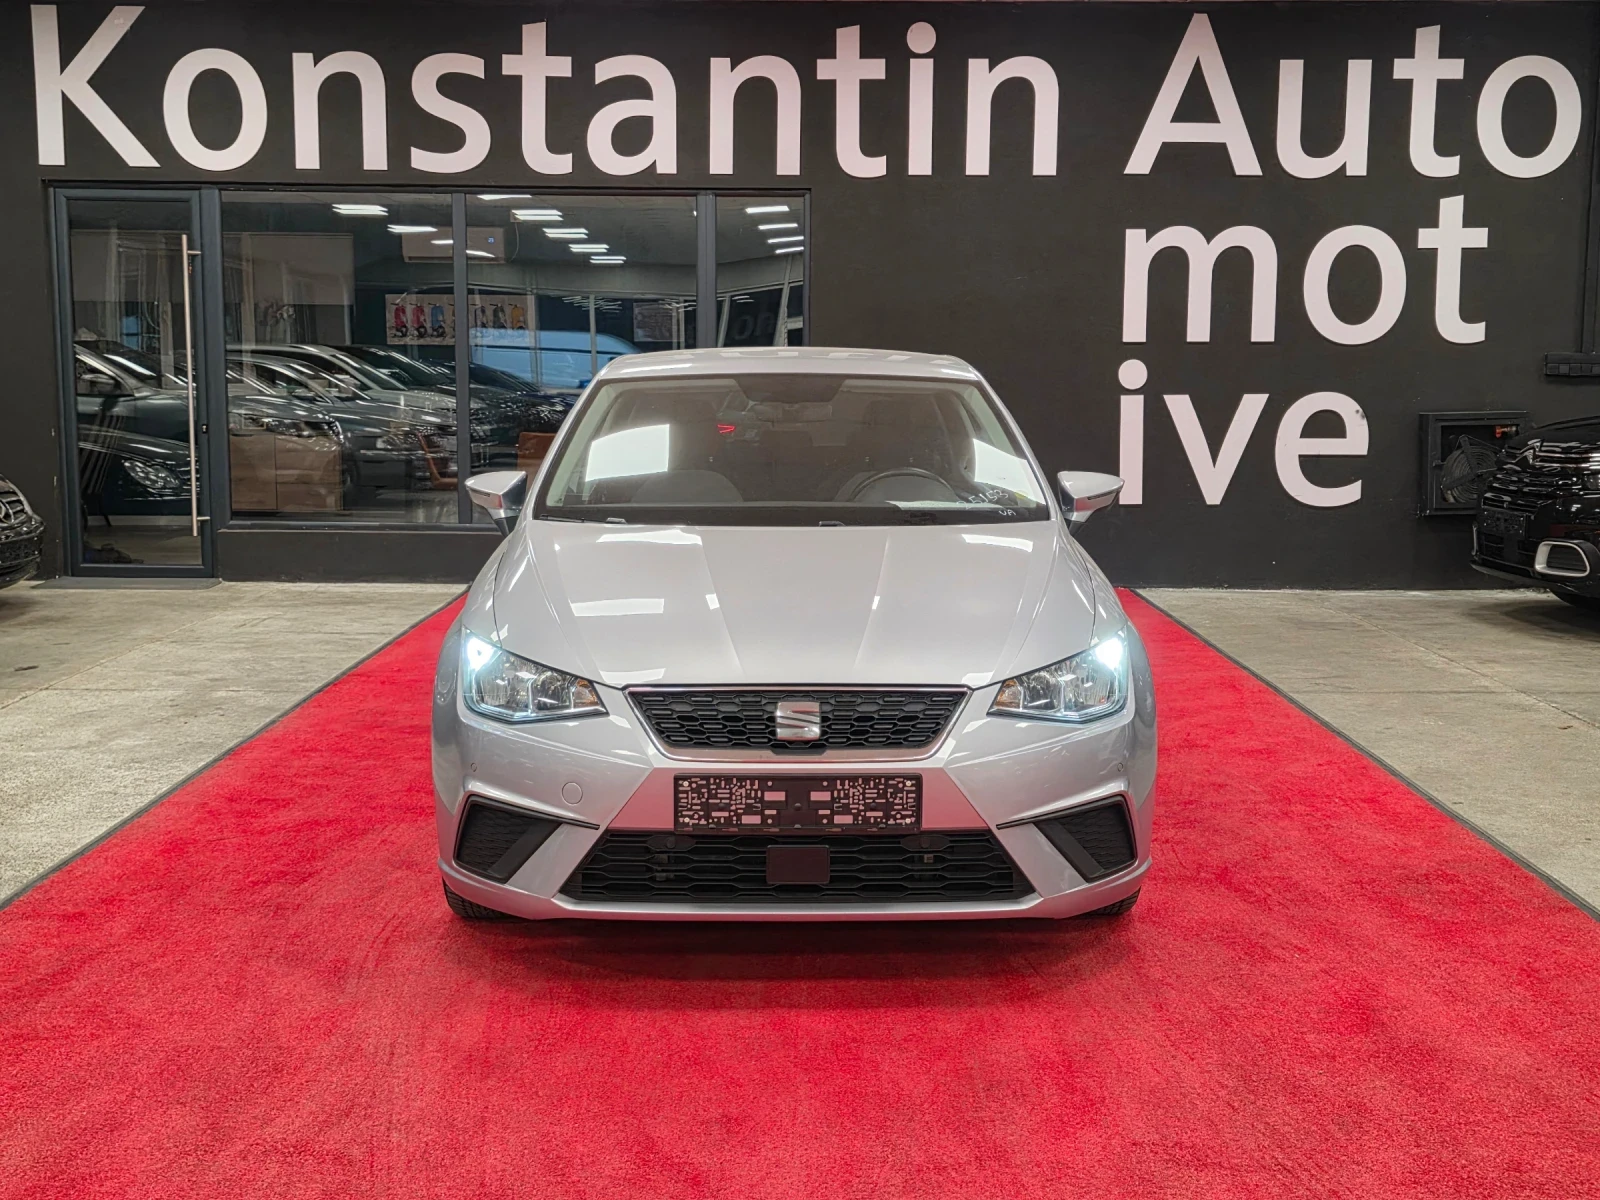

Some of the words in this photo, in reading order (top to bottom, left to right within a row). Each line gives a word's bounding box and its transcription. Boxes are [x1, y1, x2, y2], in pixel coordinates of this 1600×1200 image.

[31, 5, 1060, 177] Konstantin
[1124, 13, 1583, 180] Auto
[1121, 194, 1489, 345] mot
[1117, 358, 1370, 507] ive
